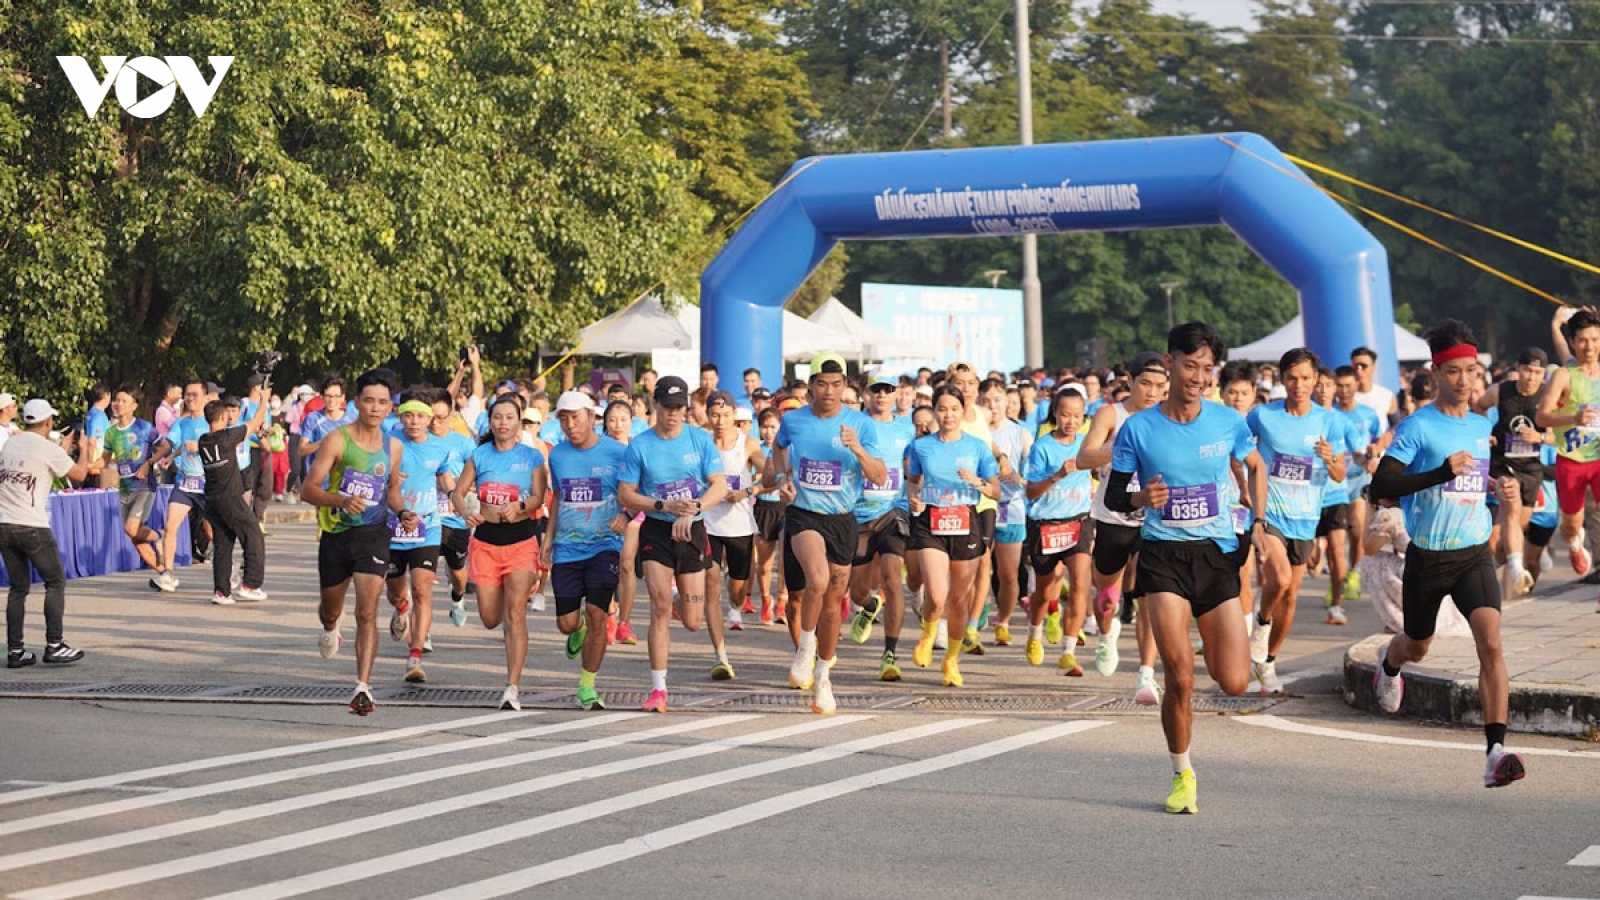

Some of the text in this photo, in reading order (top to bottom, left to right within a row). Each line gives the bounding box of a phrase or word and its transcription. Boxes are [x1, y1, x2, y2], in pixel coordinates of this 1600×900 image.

[806, 471, 834, 485] 0292
[1278, 466, 1305, 480] 0254
[571, 490, 593, 502] 0217
[1171, 502, 1209, 520] 0356
[938, 519, 962, 530] 0637
